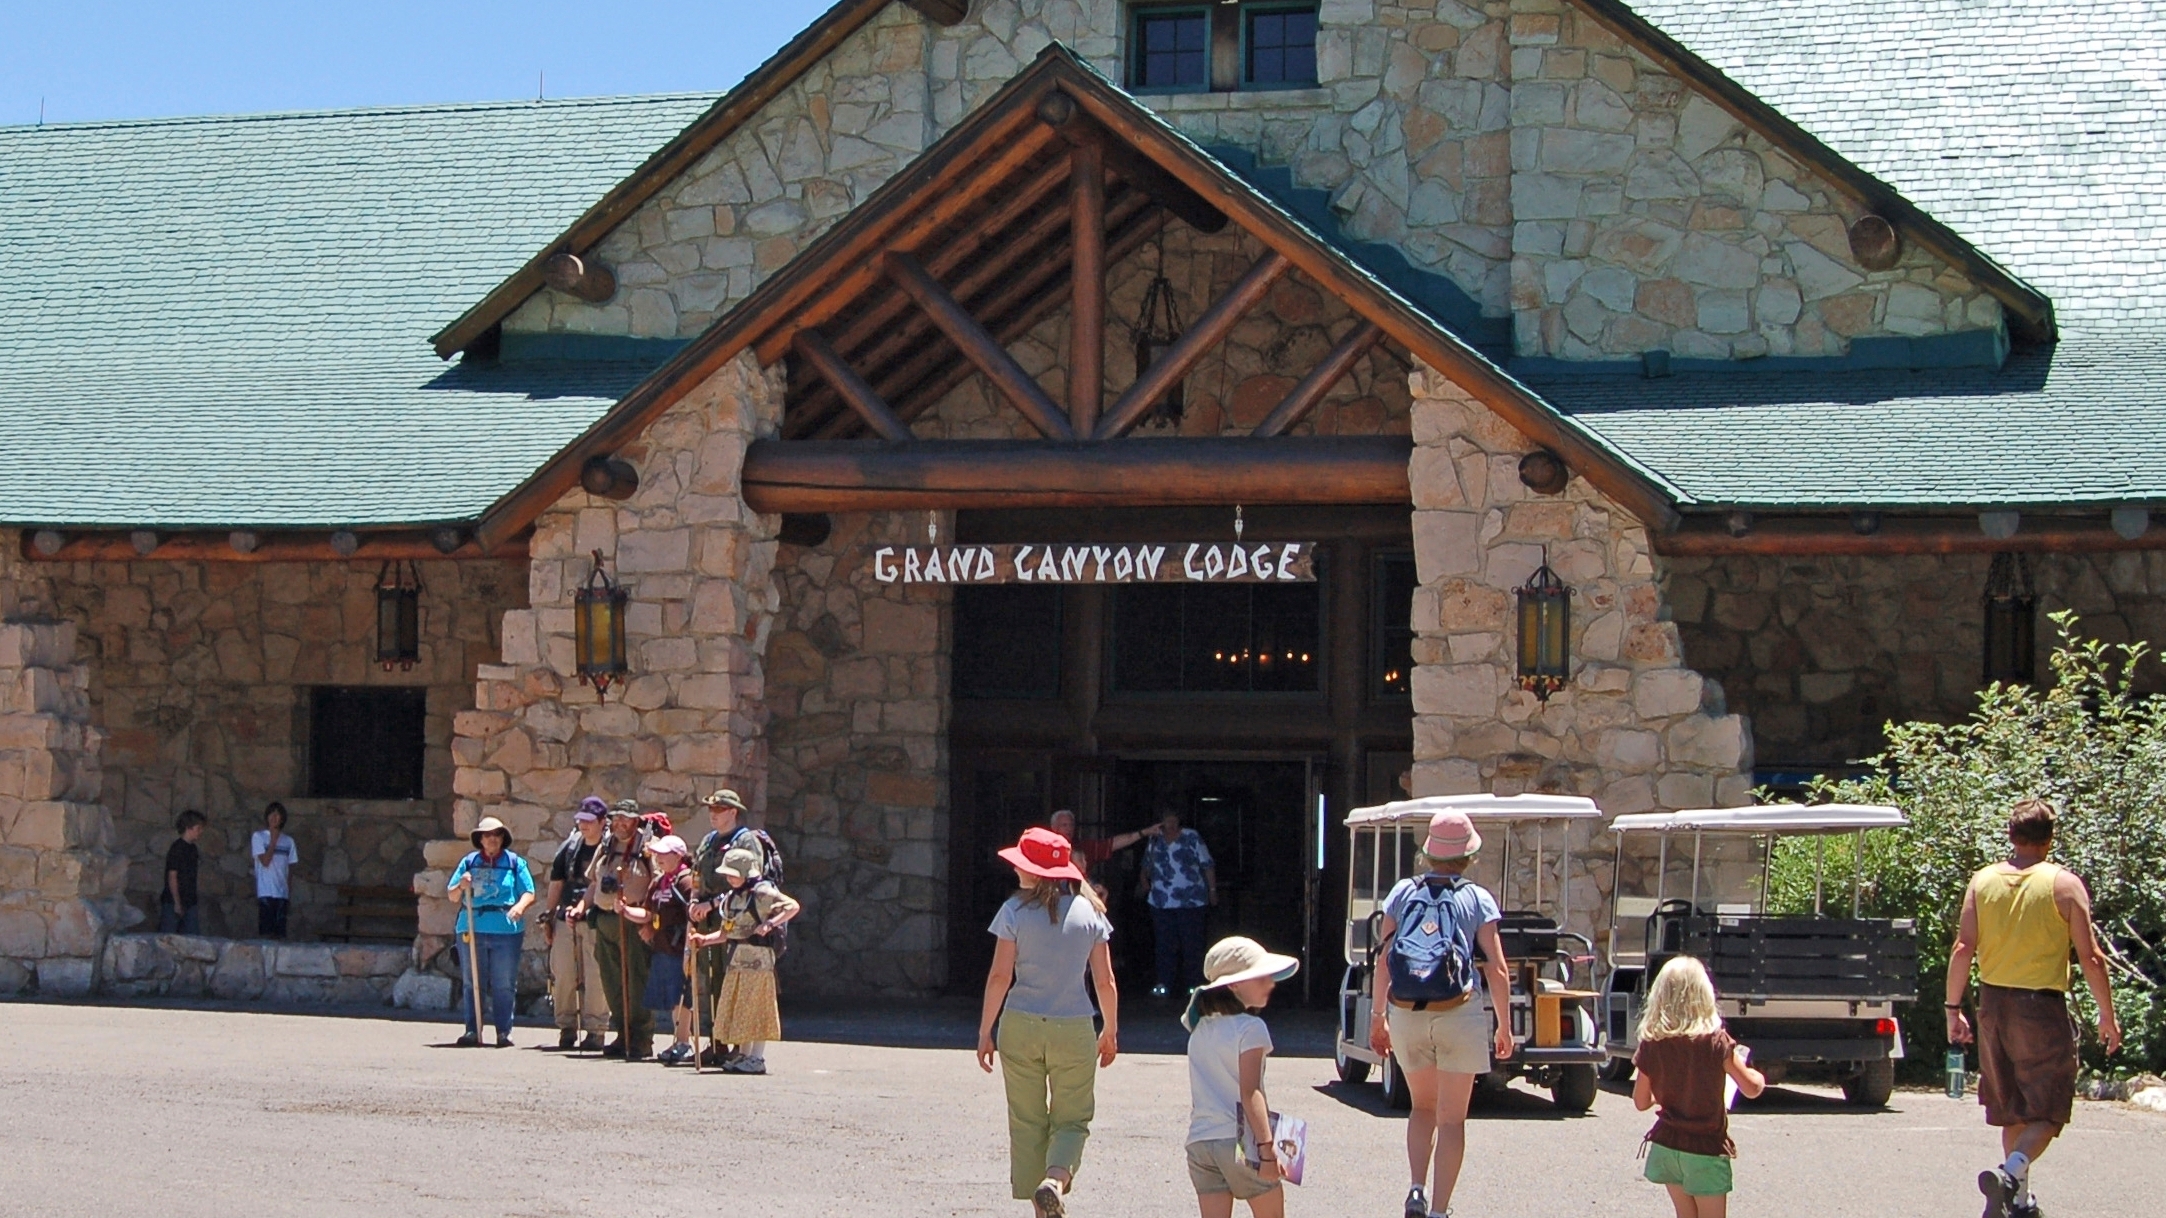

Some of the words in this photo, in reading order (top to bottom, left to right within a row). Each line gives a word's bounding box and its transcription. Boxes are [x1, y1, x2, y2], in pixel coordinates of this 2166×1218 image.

[874, 545, 995, 583] GRAND
[1013, 544, 1166, 582] CANYON
[1183, 543, 1301, 582] LODGE
